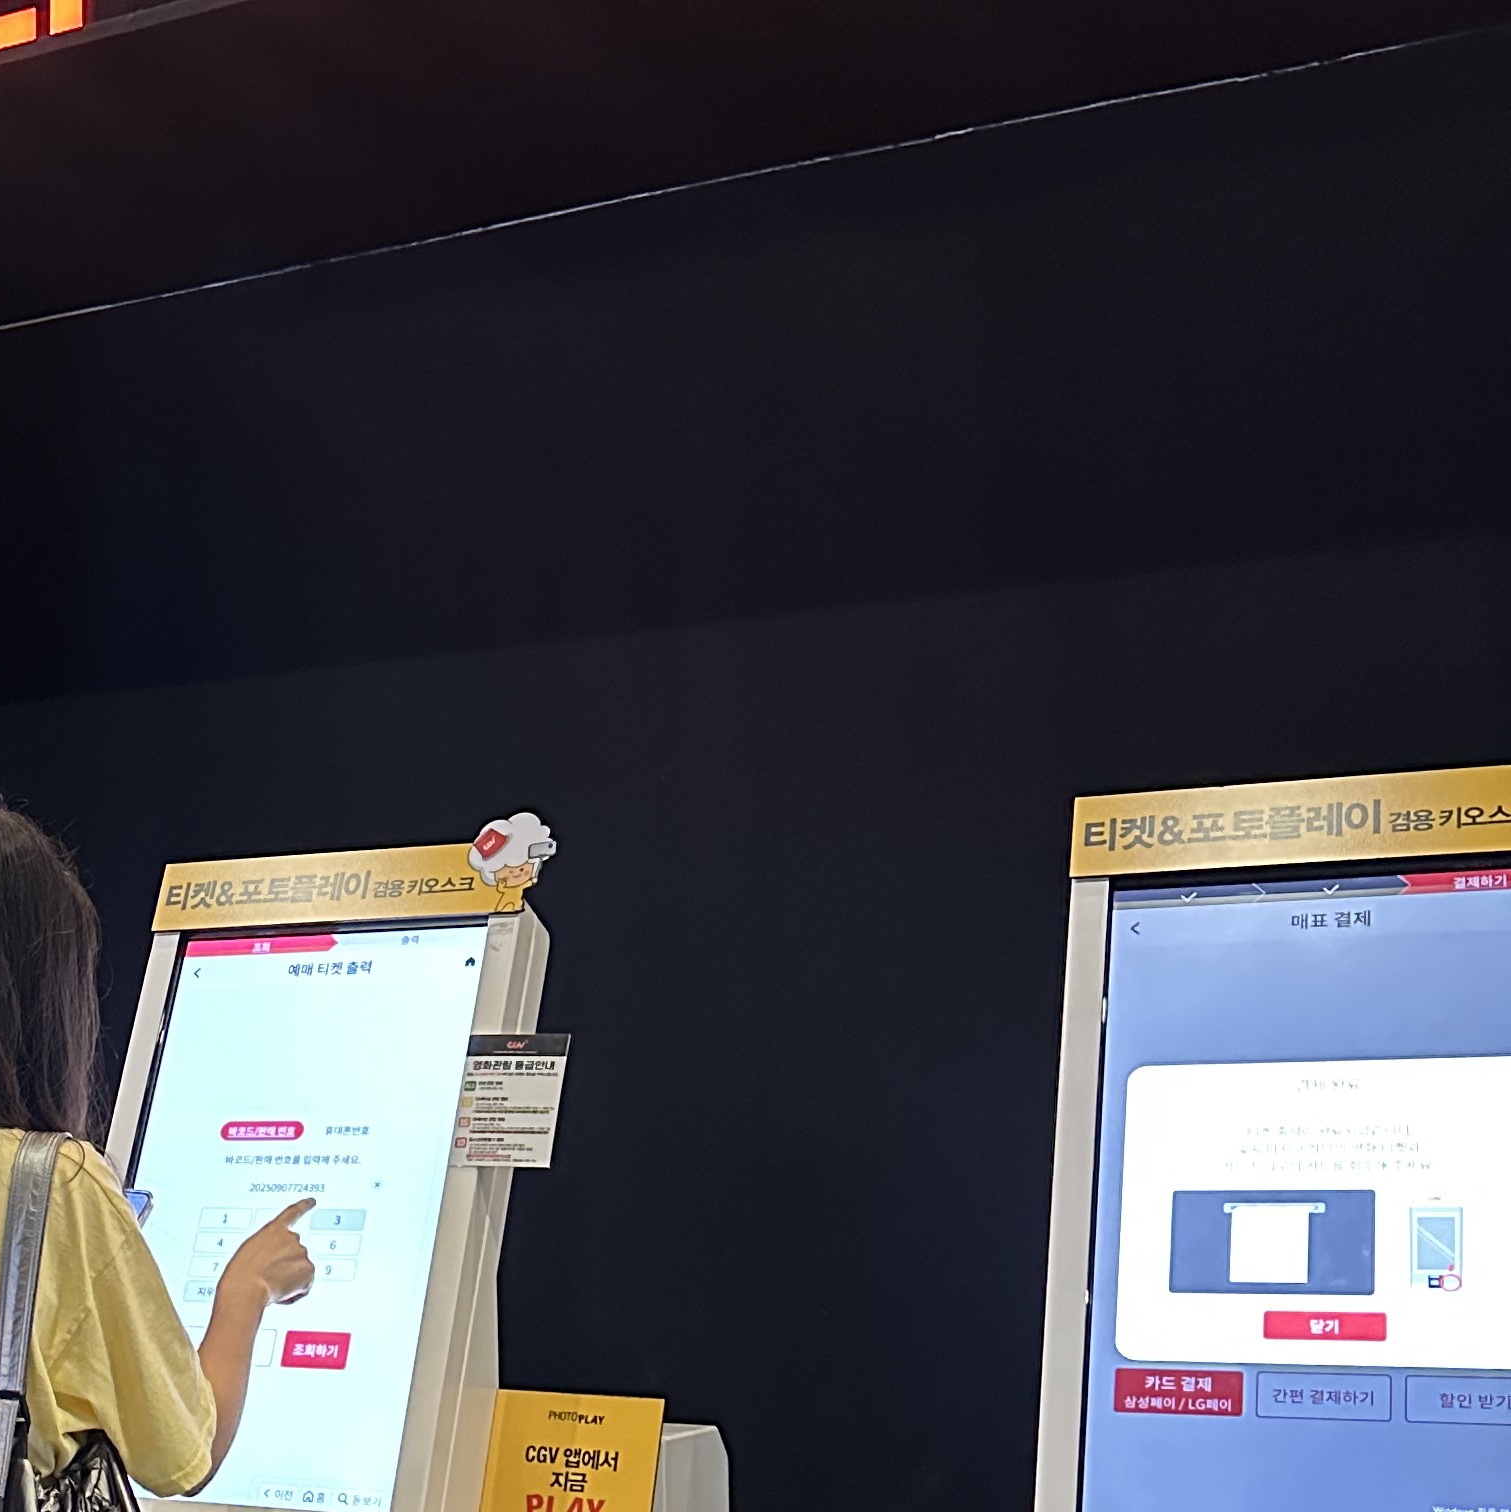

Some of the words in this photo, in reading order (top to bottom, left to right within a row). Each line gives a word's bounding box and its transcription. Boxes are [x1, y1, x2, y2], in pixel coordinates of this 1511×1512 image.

[1083, 799, 1382, 851] 티켓&포토플레이
[1389, 809, 1435, 832] 겸용
[165, 870, 372, 910] 티켓&포토플레이
[372, 880, 405, 898] 겸용
[407, 877, 475, 896] 키오스크
[1453, 874, 1508, 889] 결제하기
[1291, 913, 1328, 930] 매표
[1334, 909, 1372, 928] 결제
[288, 963, 314, 977] 예매
[316, 962, 342, 975] 티켓
[346, 960, 373, 975] 출력
[222, 1213, 228, 1224] 1
[333, 1214, 341, 1226] 3
[216, 1238, 224, 1248] 4
[329, 1240, 336, 1250] 6
[325, 1265, 332, 1276] 9
[197, 1286, 214, 1298] 지우
[1309, 1318, 1340, 1336] 닫기
[291, 1342, 339, 1359] 조회하기
[1144, 1375, 1177, 1392] 카드
[1180, 1376, 1212, 1393] 결제
[1124, 1394, 1176, 1411] 삼성페이
[1188, 1397, 1233, 1413] LG페이
[1271, 1388, 1304, 1404] 간편
[1308, 1388, 1375, 1407] 결제하기
[1439, 1392, 1472, 1409] 할인
[1478, 1393, 1511, 1410] 받기
[525, 1445, 560, 1464] CGV
[563, 1447, 619, 1472] 앱에서
[549, 1471, 588, 1493] 지금
[274, 1489, 294, 1502] 이전
